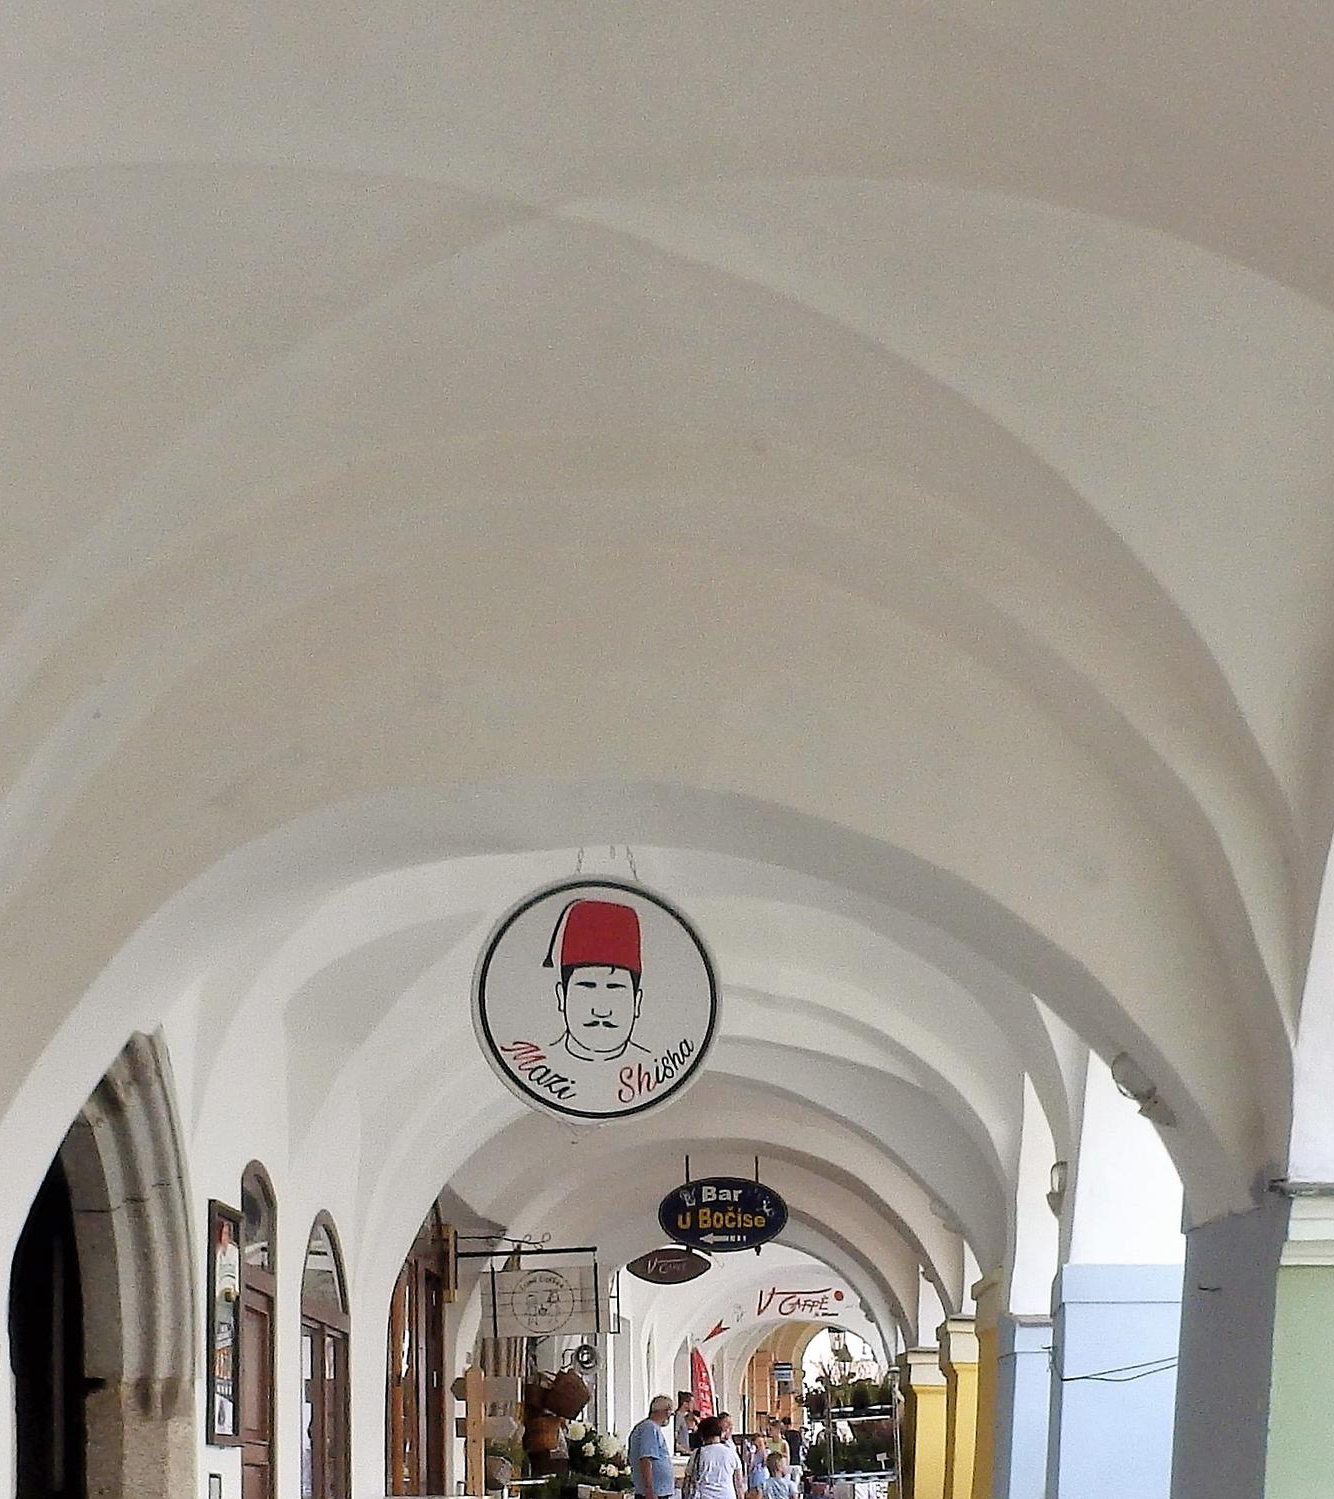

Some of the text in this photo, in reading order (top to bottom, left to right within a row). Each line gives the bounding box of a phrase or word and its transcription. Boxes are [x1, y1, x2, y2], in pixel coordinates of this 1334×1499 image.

[499, 1038, 695, 1103] Mazi Shisha
[701, 1185, 743, 1203] Bar
